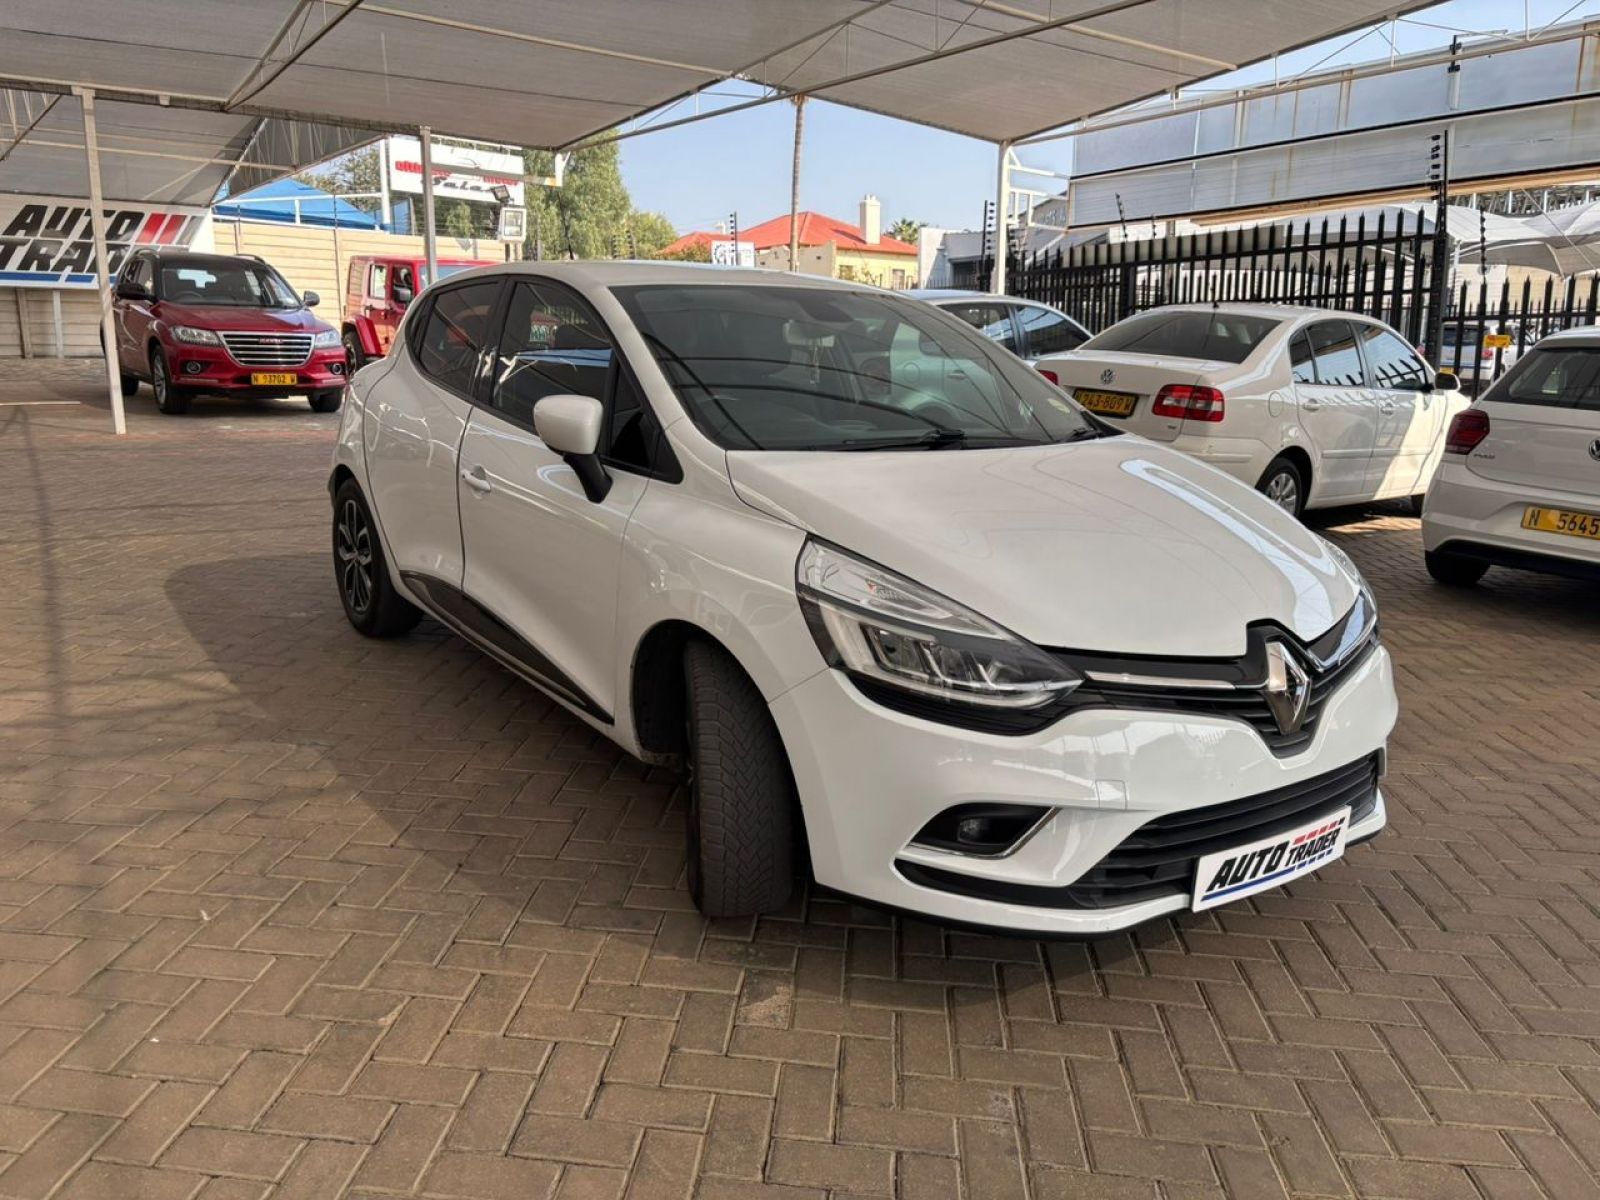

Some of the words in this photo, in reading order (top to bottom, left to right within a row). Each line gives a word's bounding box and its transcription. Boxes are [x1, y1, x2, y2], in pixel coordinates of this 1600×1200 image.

[2, 204, 145, 242] AUTO
[0, 238, 132, 274] TRAD
[1528, 509, 1541, 526] N
[1556, 513, 1600, 536] 5645
[1206, 841, 1290, 891] AUTO
[1285, 828, 1341, 867] TRADER
